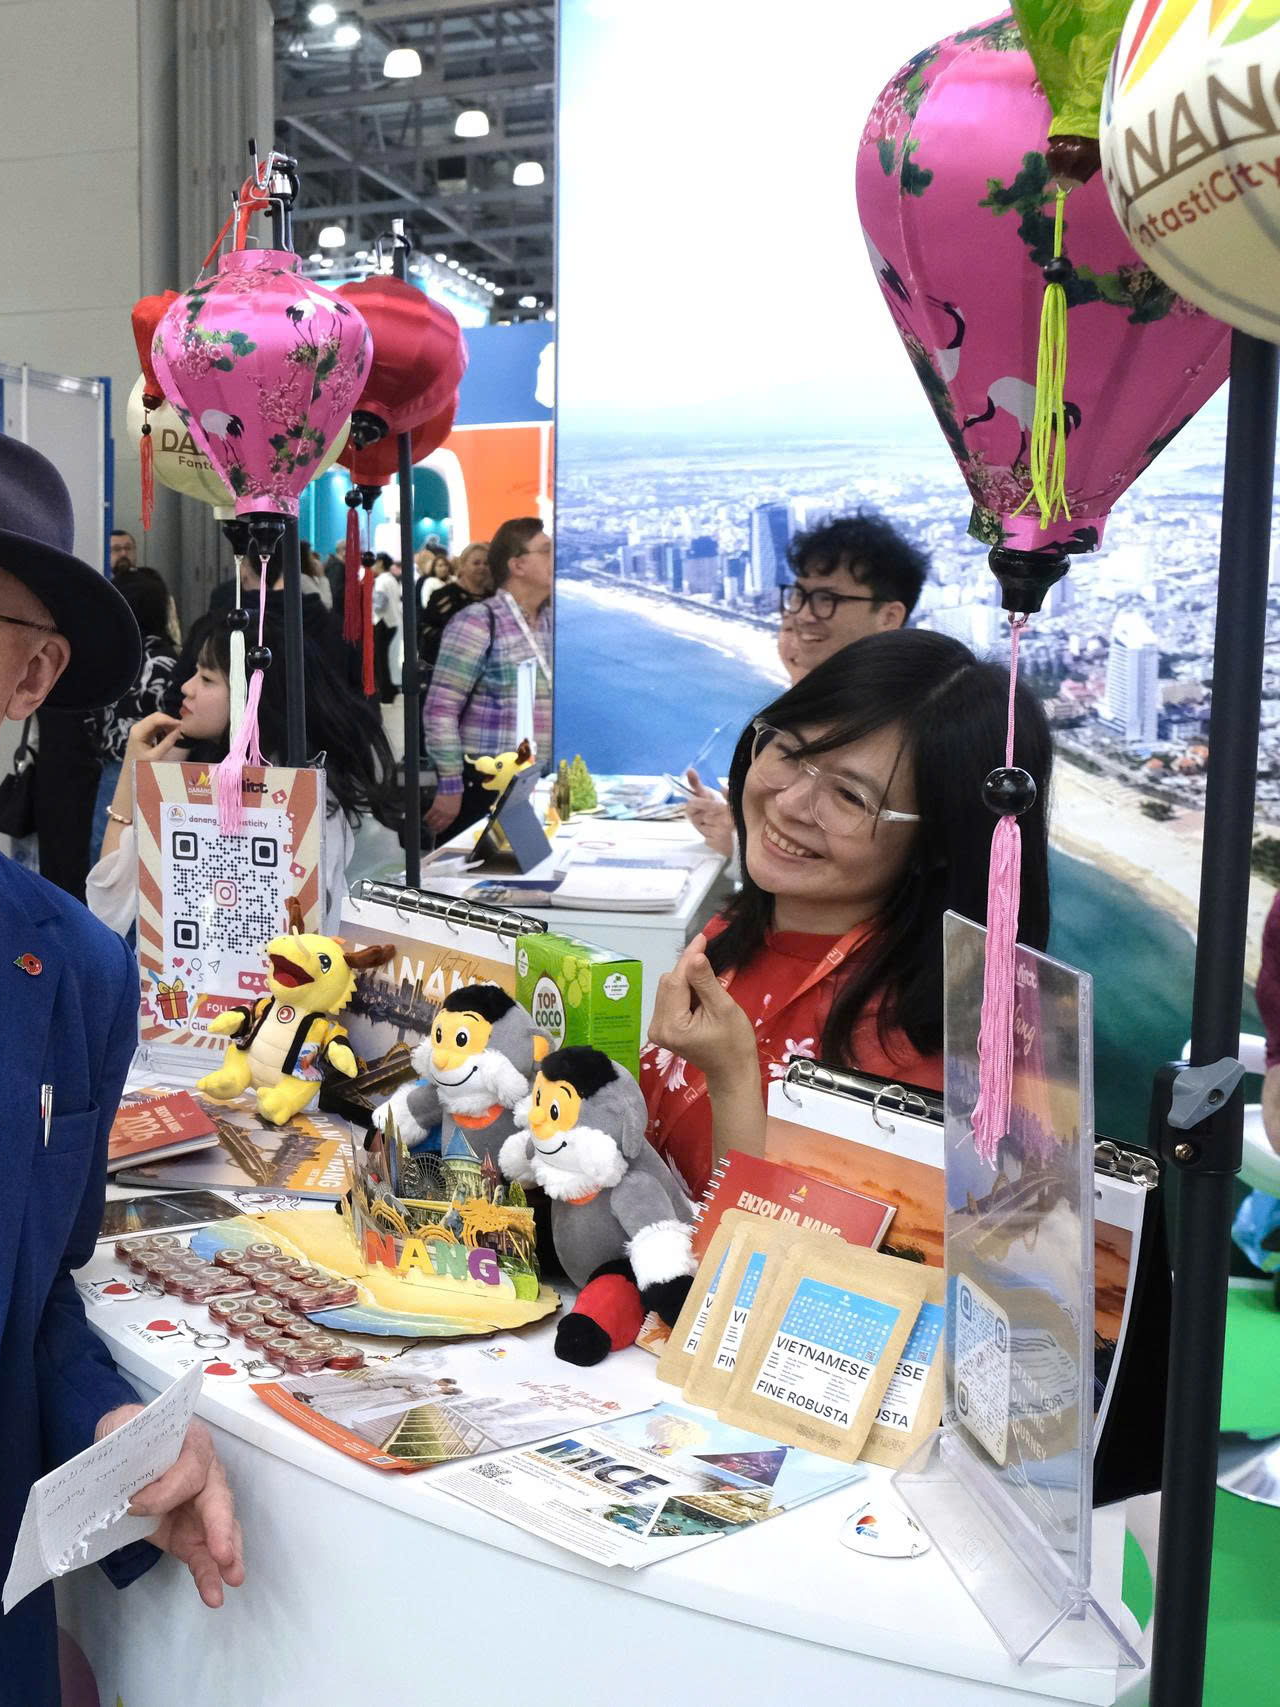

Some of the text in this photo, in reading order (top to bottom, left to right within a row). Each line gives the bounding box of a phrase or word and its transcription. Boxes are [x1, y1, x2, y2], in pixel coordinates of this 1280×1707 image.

[1124, 64, 1280, 197] NAN
[1133, 155, 1280, 247] ntastiCity
[162, 429, 202, 455] DA
[535, 1010, 562, 1027] COCO
[537, 992, 557, 1009] TOP
[191, 1022, 208, 1031] Clai
[736, 1191, 782, 1219] ENJOY
[781, 1207, 801, 1226] DA
[366, 1229, 501, 1286] NANG
[776, 1335, 870, 1381] VIETNAMESE
[756, 1379, 787, 1399] FINE
[786, 1391, 849, 1425] ROBUSTA
[520, 1450, 564, 1472] DANANG
[565, 1469, 634, 1501] FANTASTICITY
[535, 1438, 671, 1495] MICE
